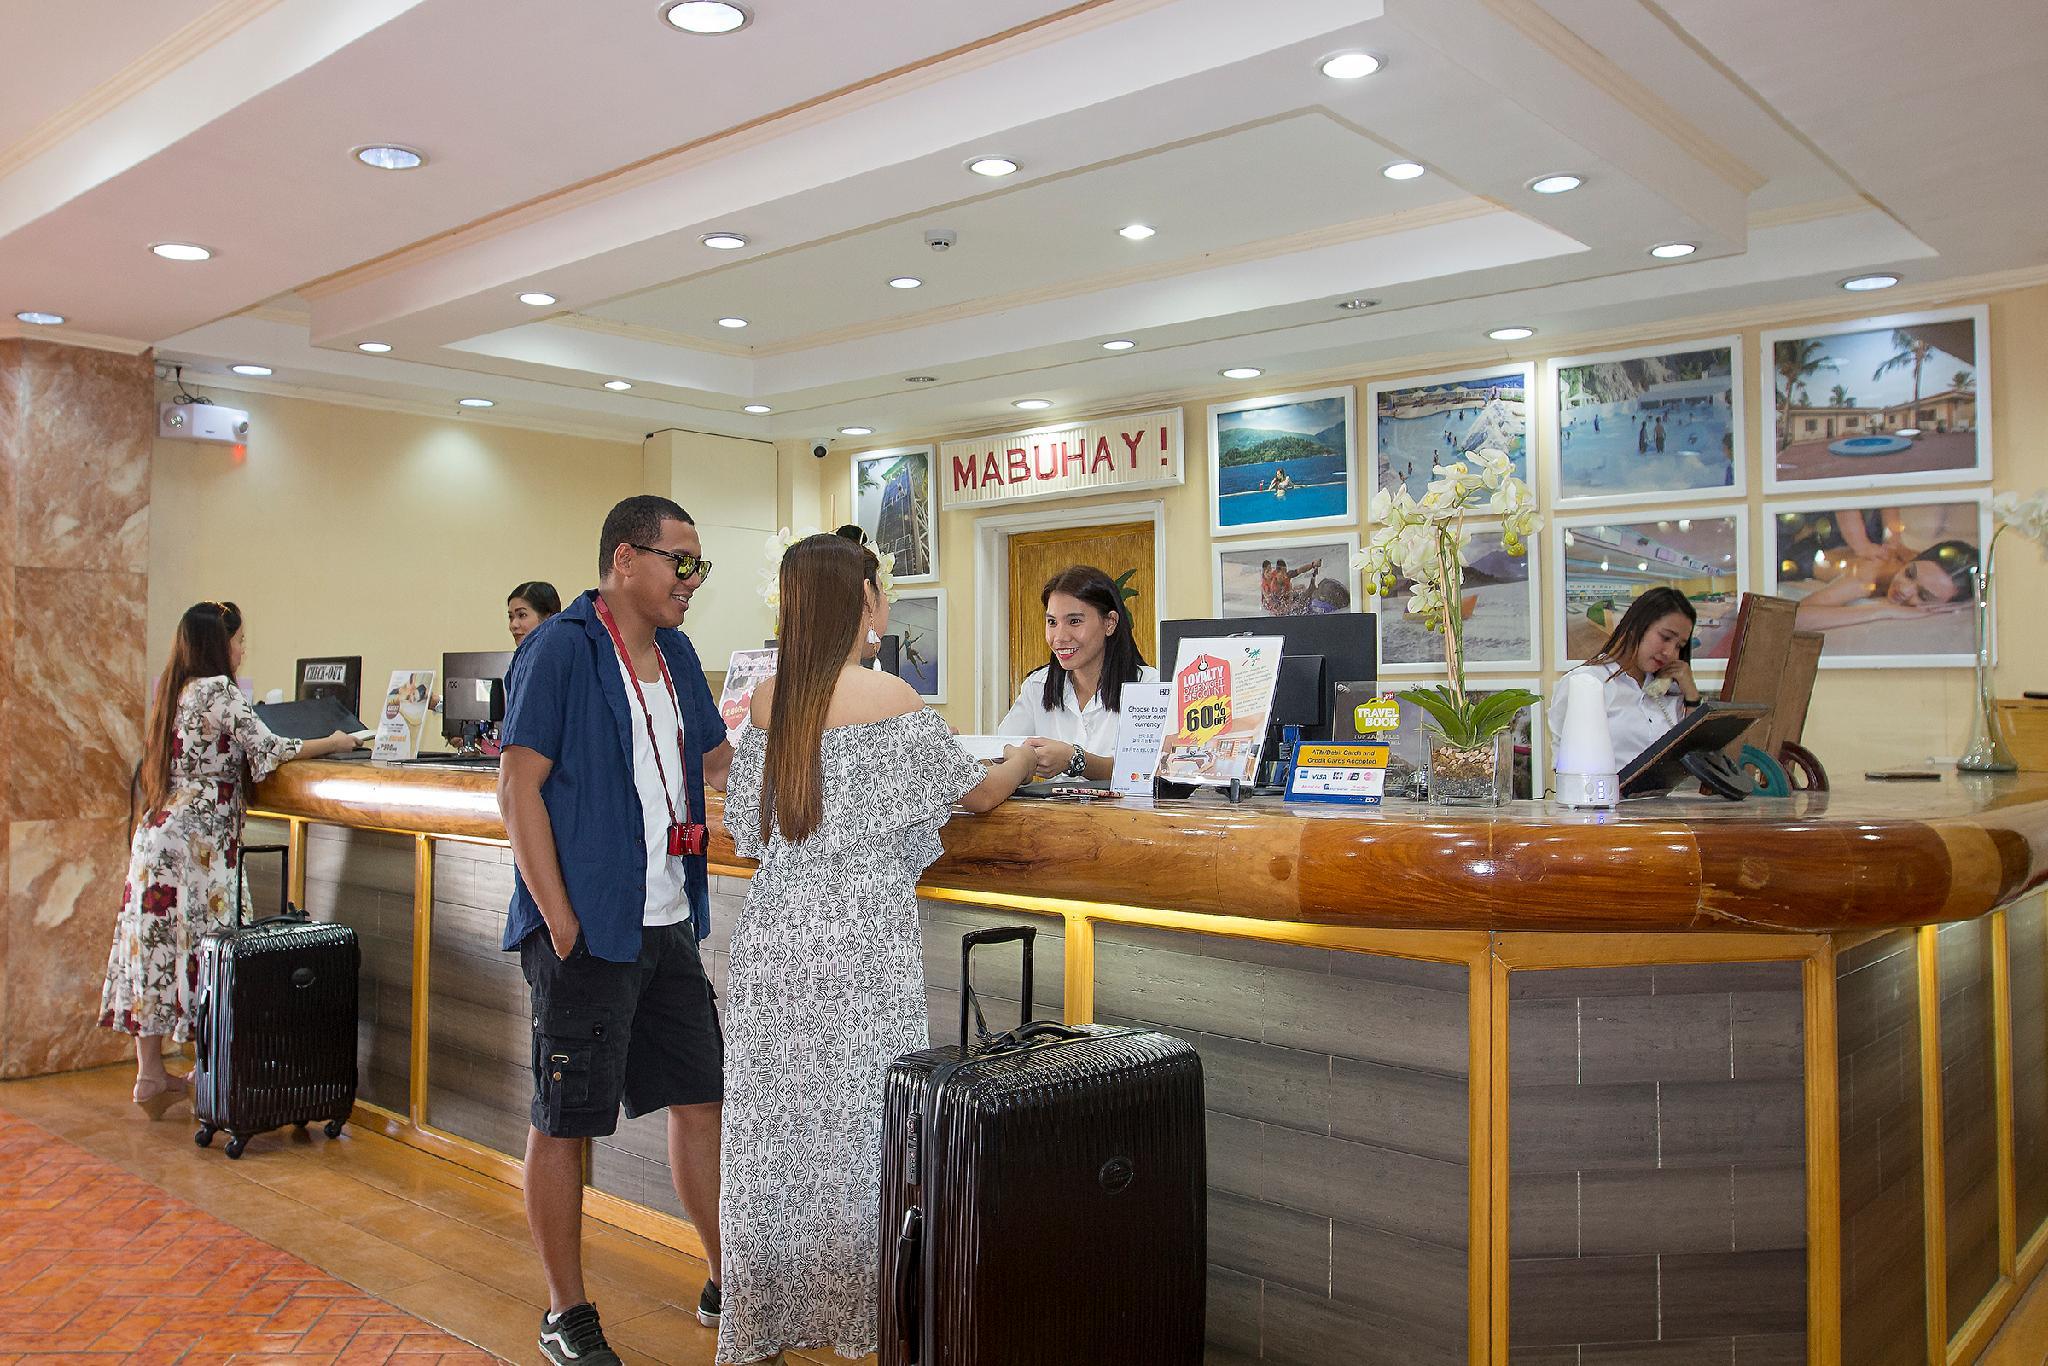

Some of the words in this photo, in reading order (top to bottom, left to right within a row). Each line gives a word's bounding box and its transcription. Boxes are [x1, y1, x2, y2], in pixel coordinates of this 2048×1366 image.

[305, 665, 343, 681] CHECK-OUT
[1183, 665, 1224, 688] LOYALTY
[1184, 677, 1224, 695] OVERNIGHT
[1184, 684, 1225, 703] DISCOUNT
[1128, 705, 1150, 713] Choose
[1357, 707, 1400, 718] TRAVEL
[1214, 715, 1227, 726] OFF
[1365, 717, 1399, 727] BOOK
[1343, 749, 1362, 757] Cards
[1363, 749, 1376, 757] and
[1327, 757, 1346, 765] Cards
[1346, 757, 1377, 765] Accepted
